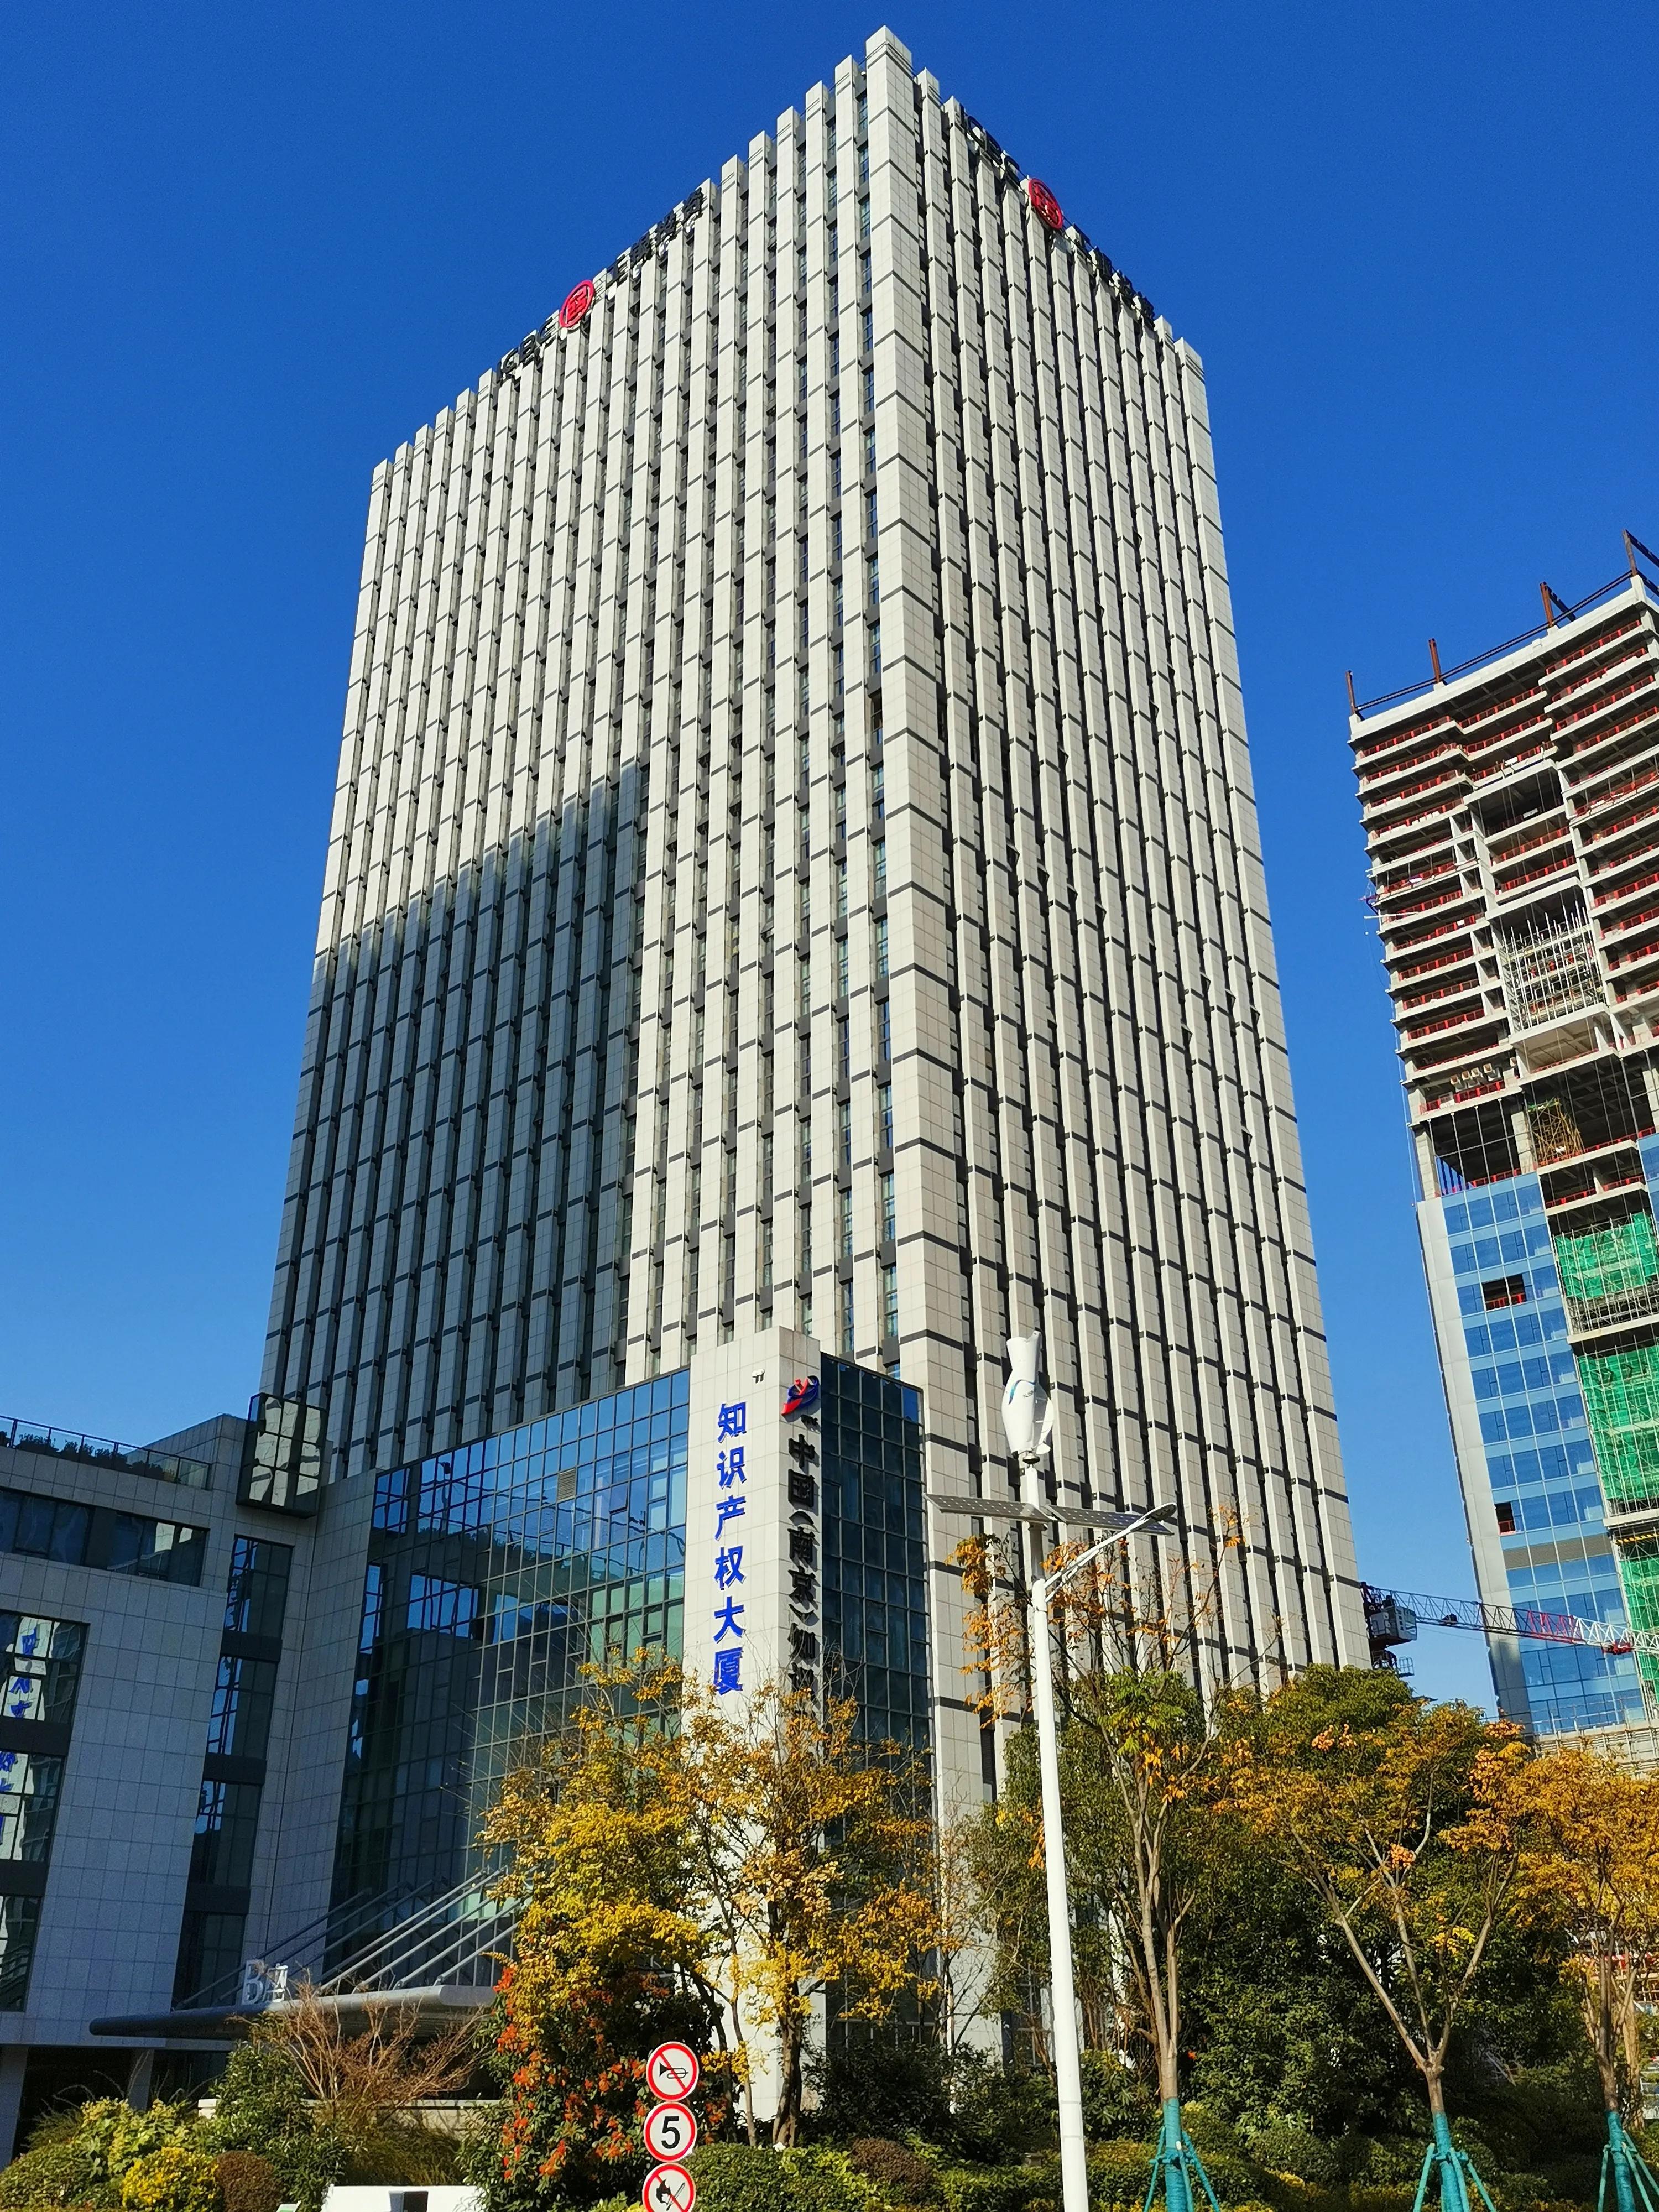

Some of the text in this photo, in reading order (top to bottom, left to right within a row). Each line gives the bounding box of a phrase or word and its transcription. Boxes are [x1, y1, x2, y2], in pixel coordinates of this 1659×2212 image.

[496, 317, 555, 383] ICBC
[712, 1401, 747, 1695] 知识产权大厦
[661, 2116, 680, 2149] 5
